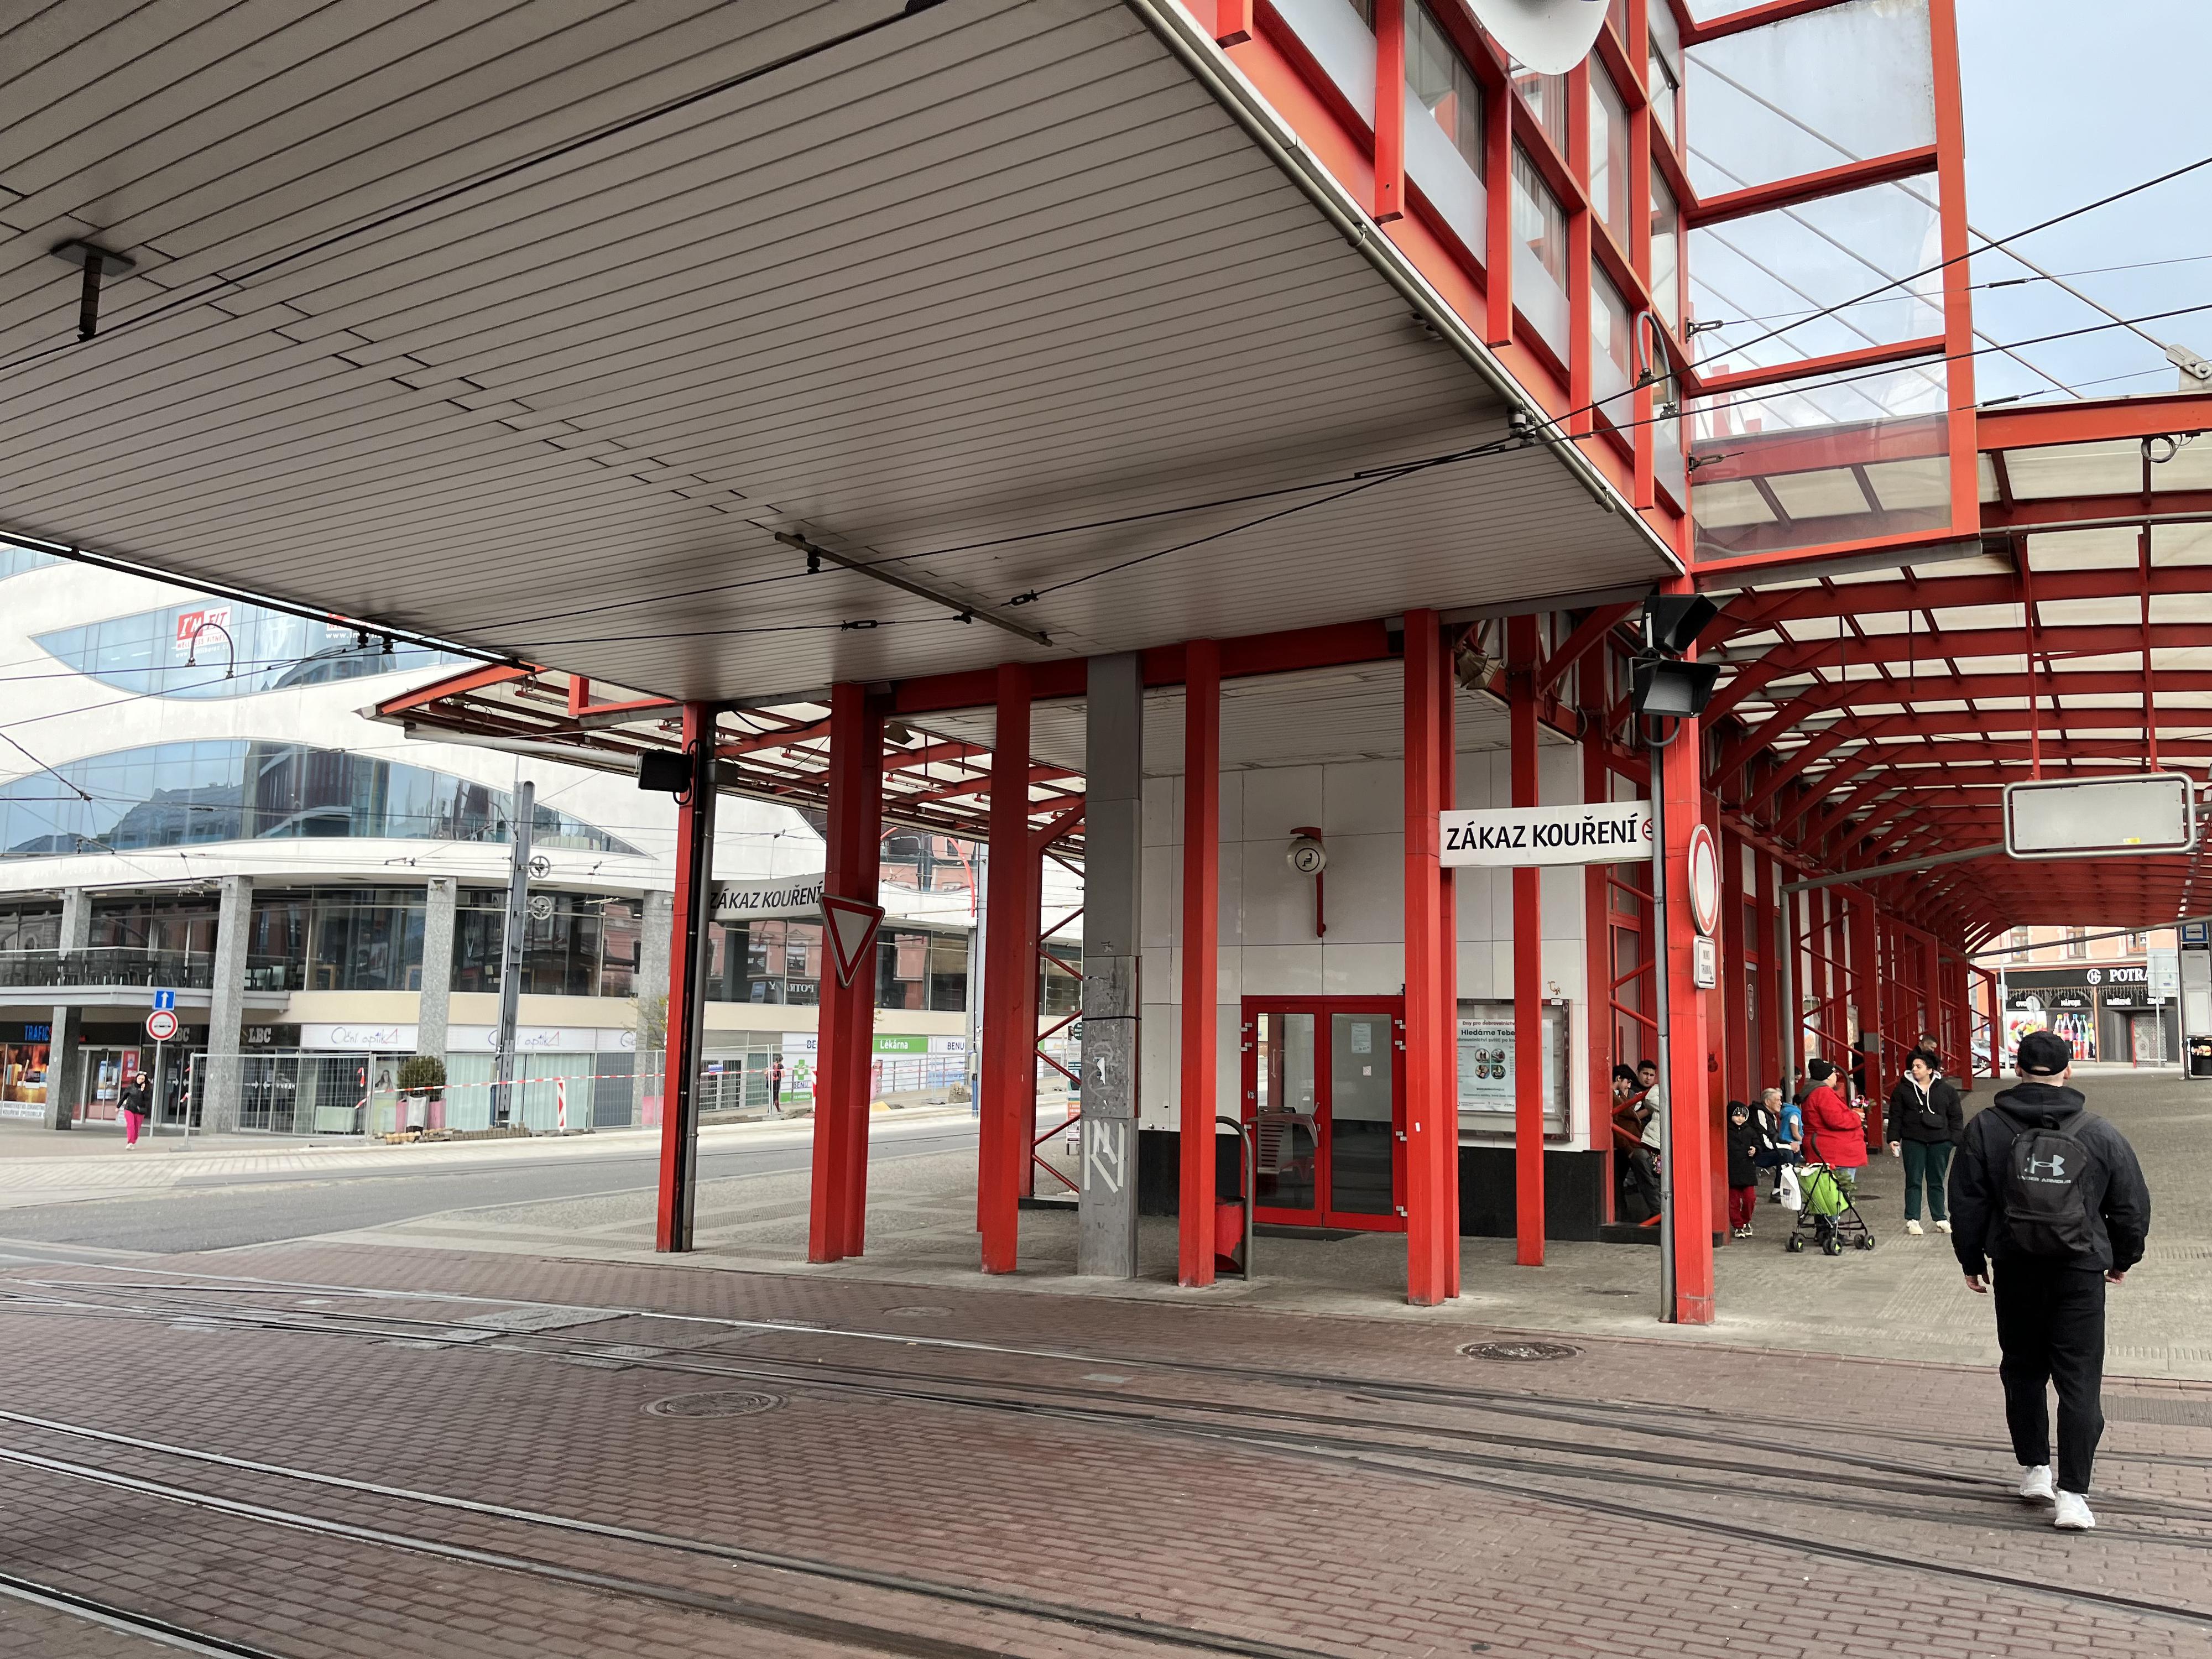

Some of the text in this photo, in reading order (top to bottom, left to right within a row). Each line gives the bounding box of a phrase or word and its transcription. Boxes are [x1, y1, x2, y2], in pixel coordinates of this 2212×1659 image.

[206, 612, 228, 629] FIT
[178, 638, 204, 649] WELLSS
[1447, 813, 1638, 850] ZÁKAZ KOUŘENÍ
[711, 880, 823, 909] ZÁKAZ KOUŘENÍ
[2109, 968, 2148, 982] POTRA
[24, 1025, 51, 1041] TRAFIC
[249, 1027, 271, 1043] LBC
[331, 1027, 359, 1044] Oční
[807, 1040, 816, 1048] BE
[880, 1040, 909, 1050] Lékárna
[947, 1042, 964, 1050] BENU
